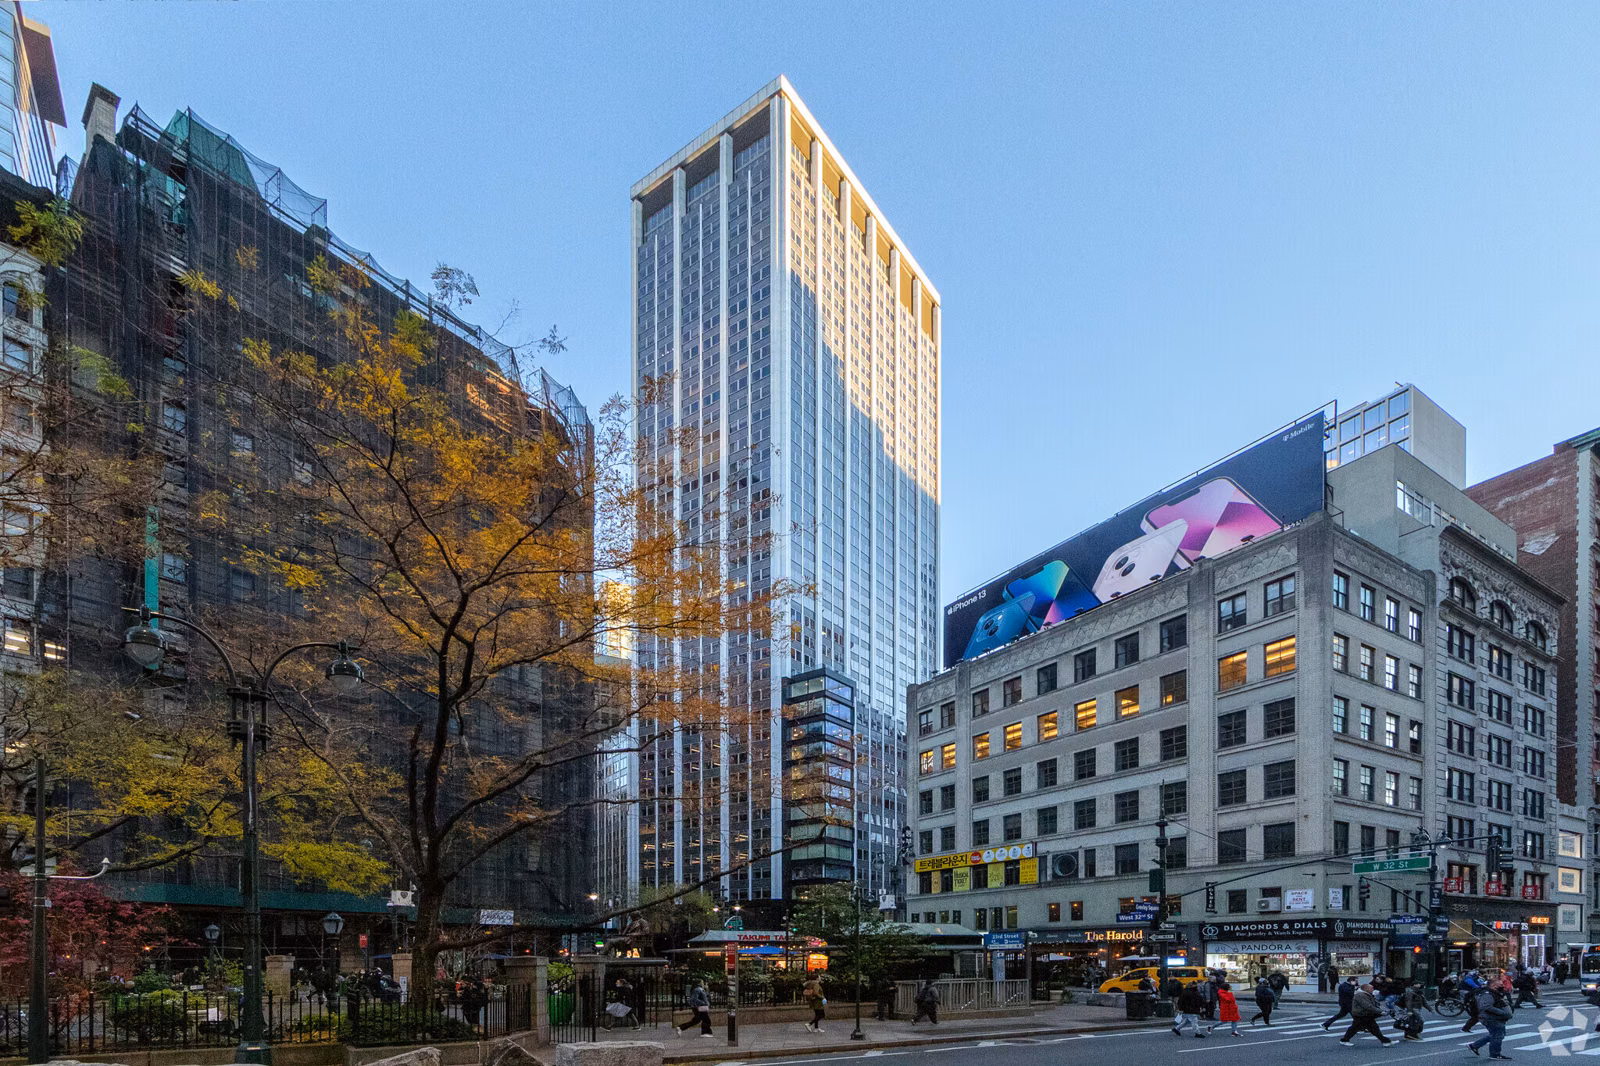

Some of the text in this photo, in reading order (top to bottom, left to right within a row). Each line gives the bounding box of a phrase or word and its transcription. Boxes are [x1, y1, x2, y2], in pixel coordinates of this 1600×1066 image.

[952, 589, 987, 612] iPhone 13
[1223, 924, 1278, 932] DIAMONDS
[1085, 931, 1104, 940] The
[1106, 930, 1142, 940] Harold
